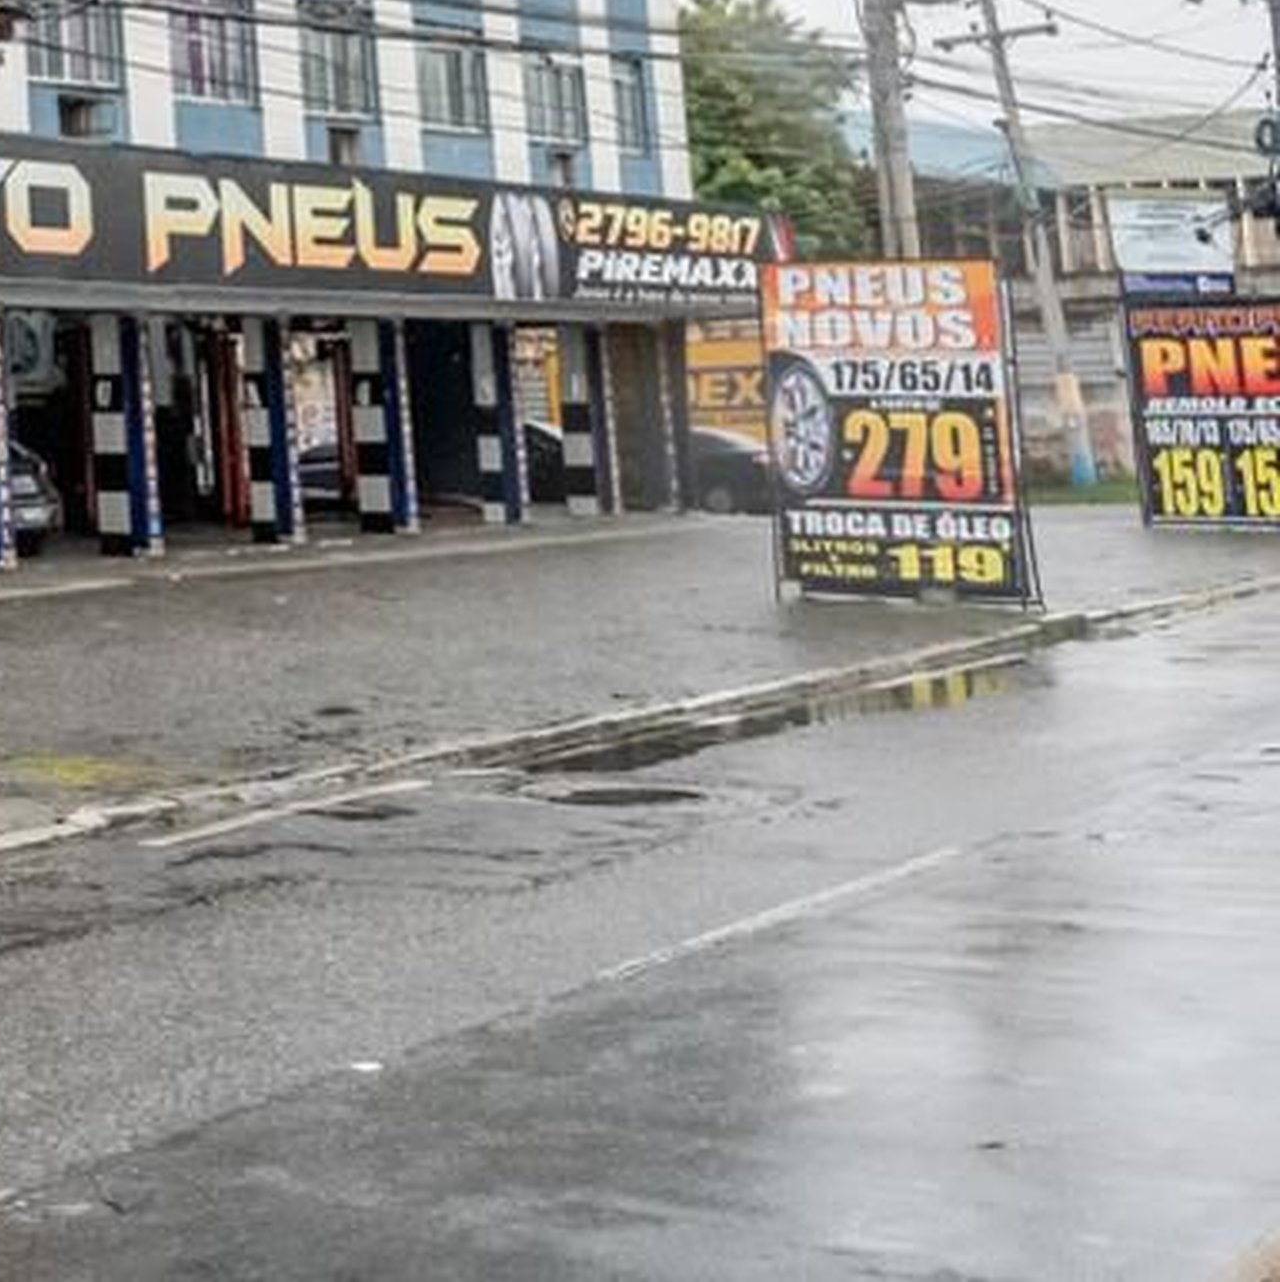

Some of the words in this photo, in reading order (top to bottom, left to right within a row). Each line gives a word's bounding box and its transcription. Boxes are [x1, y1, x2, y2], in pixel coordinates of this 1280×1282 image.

[142, 172, 482, 278] PNEUS
[778, 264, 967, 306] PNEUS
[779, 307, 977, 348] NOVOS
[831, 360, 995, 393] 175/65/14
[843, 408, 984, 500] 279
[1153, 448, 1225, 516] 159
[787, 510, 886, 536] TROCA
[892, 512, 930, 538] DE
[886, 542, 1005, 584] 119
